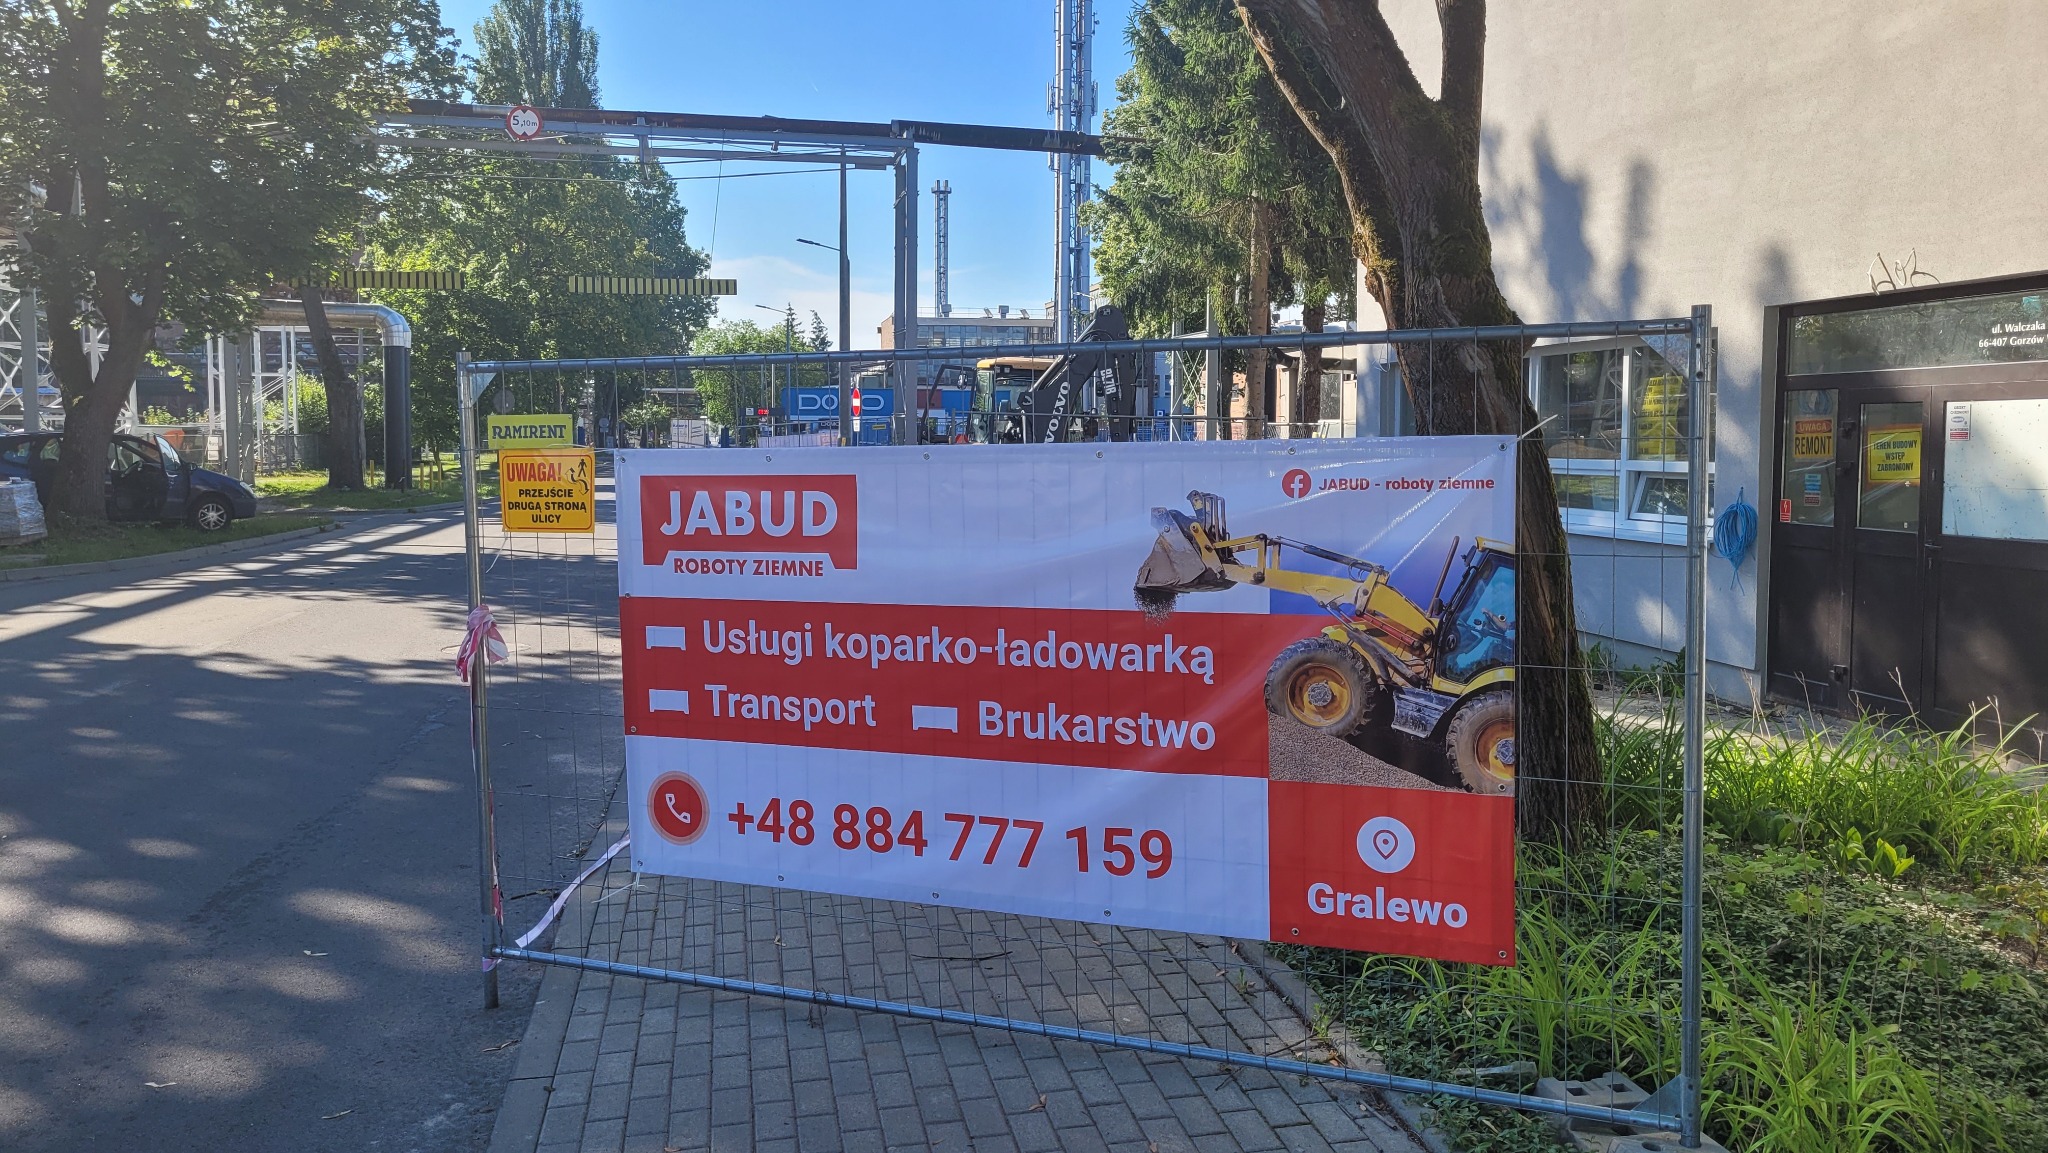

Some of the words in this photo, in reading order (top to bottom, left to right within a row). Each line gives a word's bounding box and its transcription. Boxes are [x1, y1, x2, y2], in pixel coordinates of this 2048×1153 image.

[1991, 323, 2003, 334] ul.
[2004, 320, 2046, 334] Walczaka
[1978, 337, 2008, 348] 66-407
[2009, 334, 2045, 346] Gorzów
[798, 394, 885, 411] DOO
[491, 424, 567, 440] RAMIRENT
[1799, 422, 1827, 432] UWAGA
[1794, 435, 1832, 455] REMONT
[1892, 439, 1918, 449] BUDOWY
[1884, 451, 1906, 462] WSTĘP
[506, 462, 562, 482] UWAGA!
[1876, 462, 1914, 472] ZABRONIONY
[518, 487, 574, 498] PRZEJŚCIE
[1318, 478, 1370, 491] JABUD
[1385, 477, 1435, 492] roboty
[1438, 477, 1495, 490] ziemne
[507, 501, 542, 513] DRUGĄ
[544, 501, 587, 513] STRONĄ
[659, 490, 839, 538] JABUD
[531, 514, 562, 523] ULICY
[673, 557, 746, 576] ROBOTY
[752, 558, 824, 577] ZIEMNE
[702, 619, 813, 666] Usługi
[824, 622, 1215, 685] koparko-ładowarką
[704, 684, 877, 732] Transport
[978, 700, 1216, 751] Brukarstwo
[727, 797, 815, 847] +48
[832, 803, 928, 857] 884
[944, 812, 1044, 868] 777
[1065, 825, 1173, 879] 159
[1307, 882, 1468, 928] Gralewo
